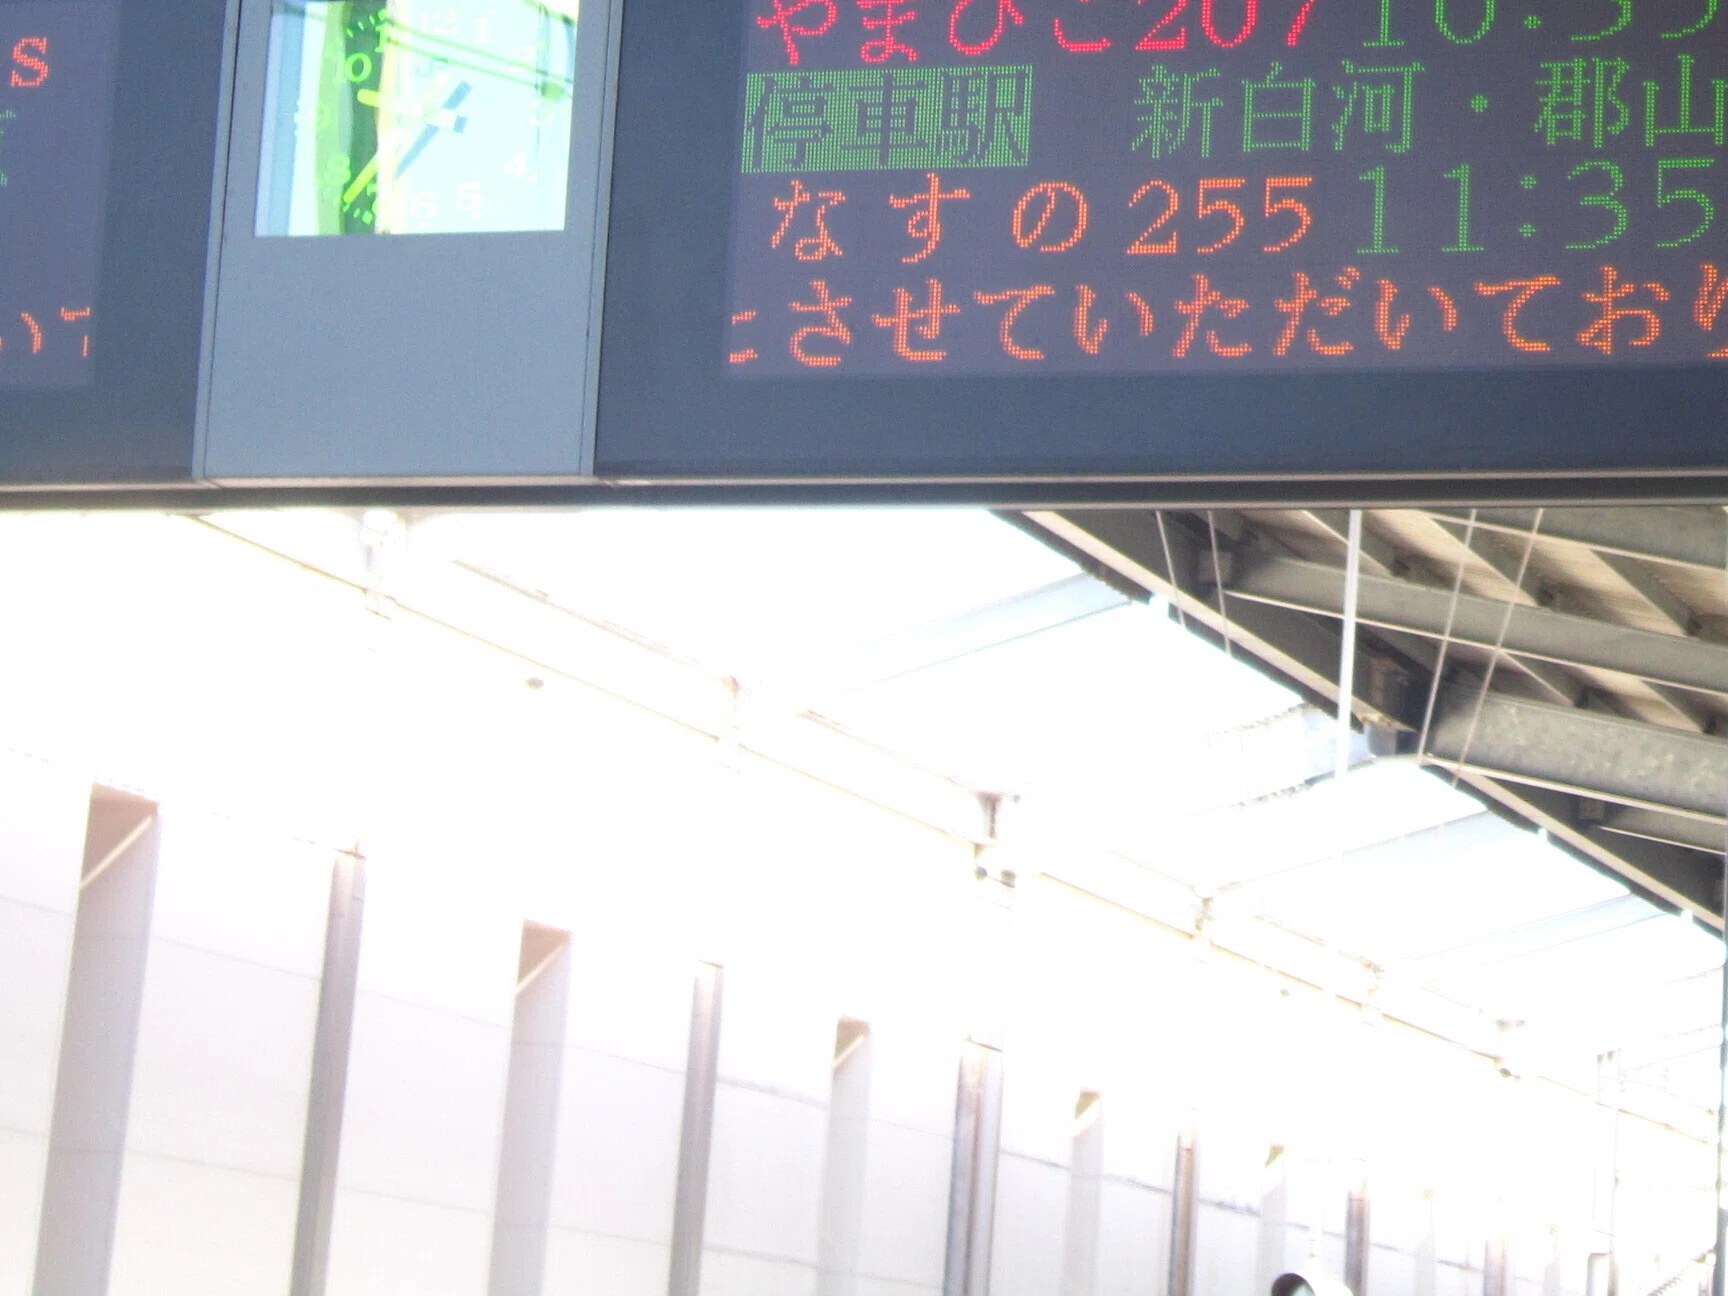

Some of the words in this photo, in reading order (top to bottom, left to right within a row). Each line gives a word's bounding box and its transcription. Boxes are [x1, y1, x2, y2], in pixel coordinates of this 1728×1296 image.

[744, 65, 1032, 172] 停車駅
[1356, 157, 1716, 255] 11:35
